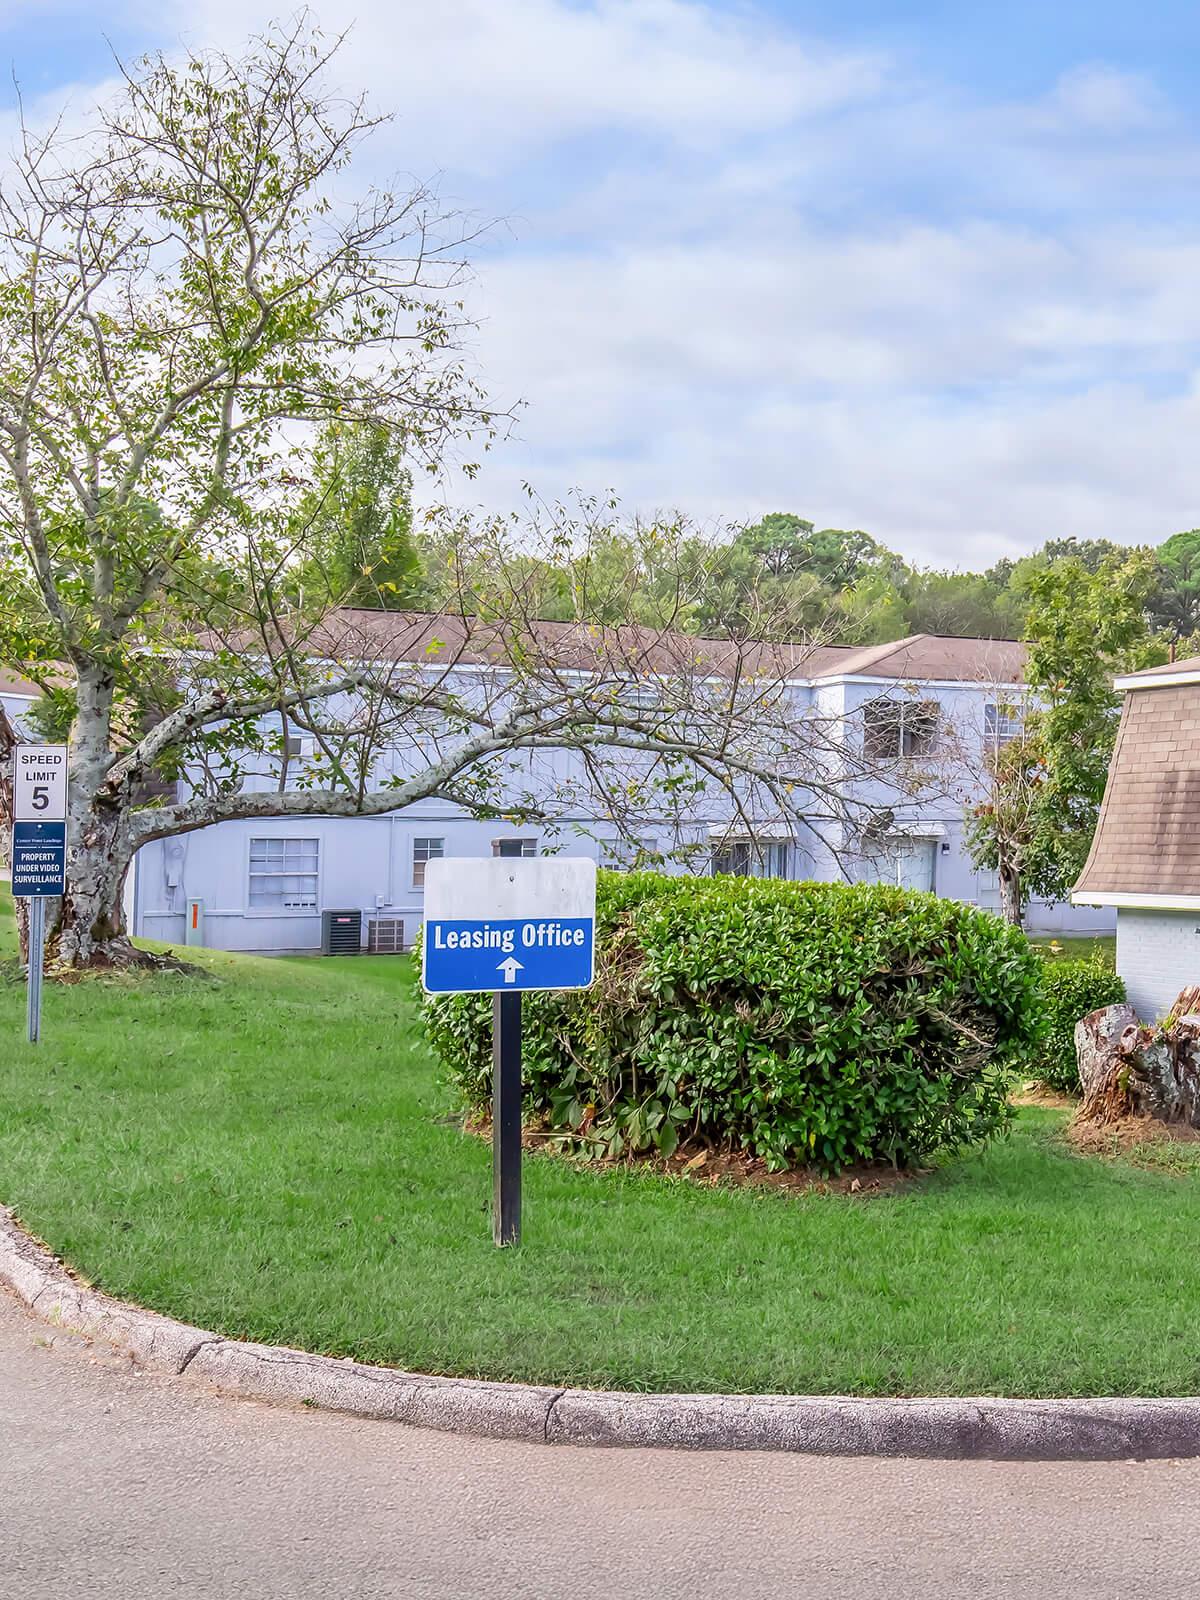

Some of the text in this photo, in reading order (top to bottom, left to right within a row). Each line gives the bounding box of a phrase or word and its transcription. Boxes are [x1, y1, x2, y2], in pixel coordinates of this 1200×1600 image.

[21, 755, 62, 764] SPEED
[26, 772, 57, 781] LIMIT
[32, 786, 49, 810] 5
[21, 853, 55, 861] PROPERTY
[16, 864, 60, 872] UNDER VIDEO
[14, 875, 62, 883] SURVEILLANCE
[434, 923, 585, 953] Leasing Office
